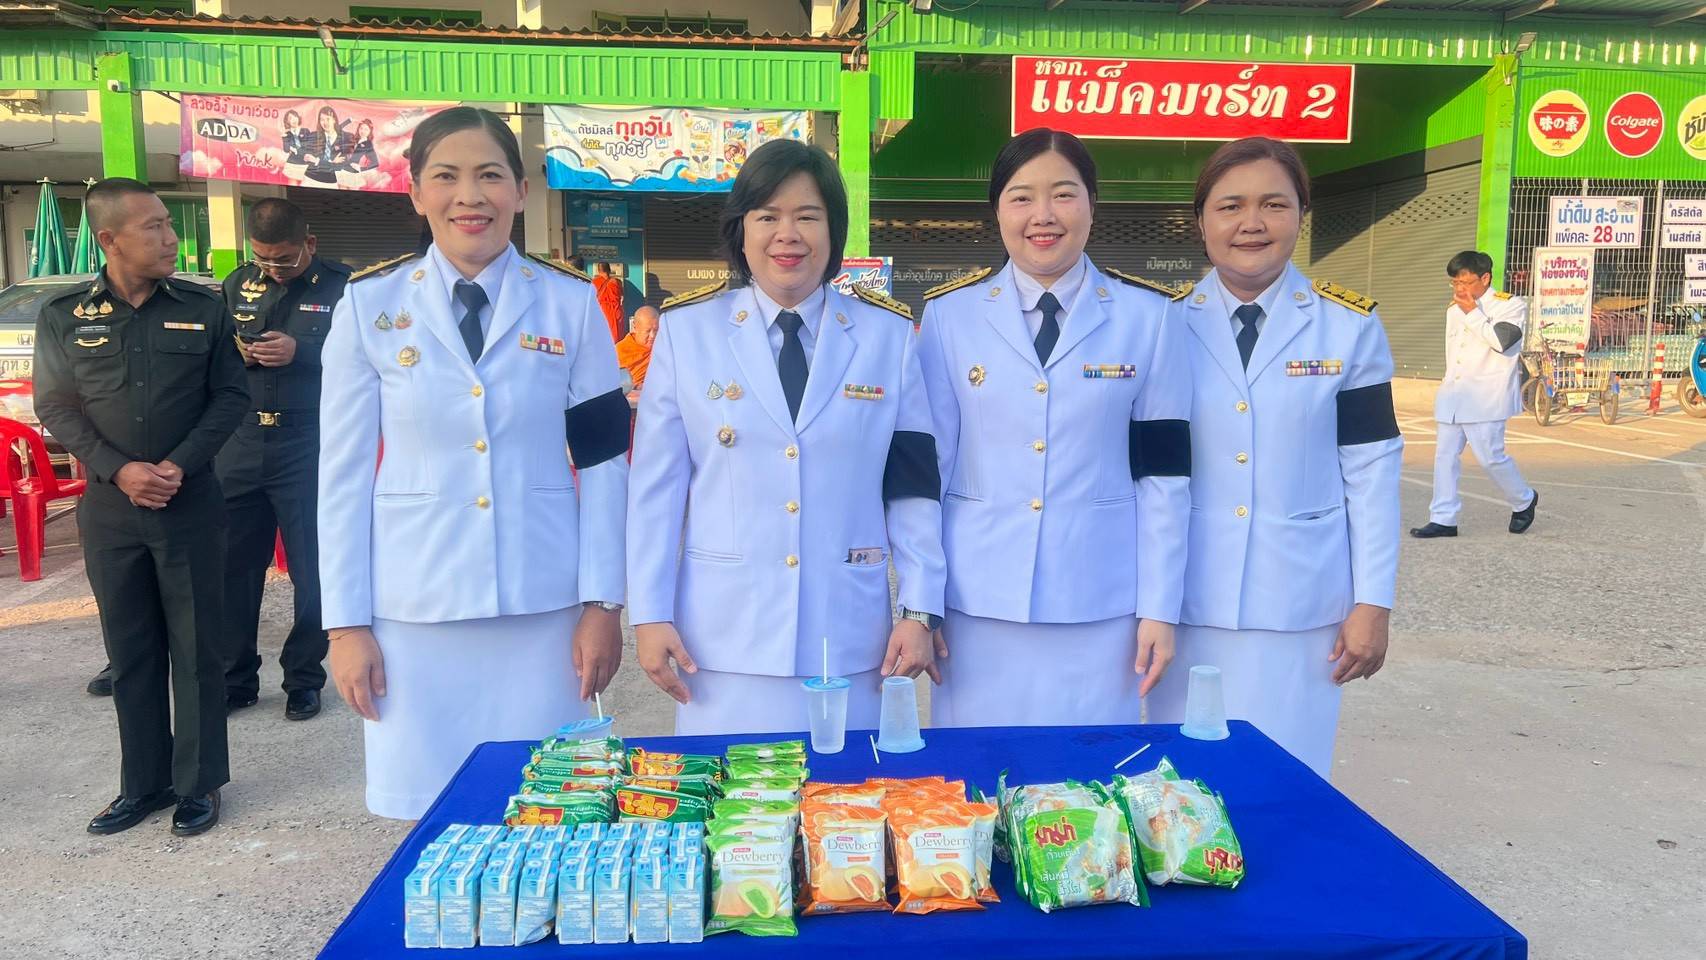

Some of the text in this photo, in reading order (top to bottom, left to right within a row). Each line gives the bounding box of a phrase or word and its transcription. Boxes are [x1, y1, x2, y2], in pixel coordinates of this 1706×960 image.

[1030, 61, 1337, 118] แม็คมาร์ท 2
[200, 121, 251, 140] ADDA
[616, 115, 673, 142] ทุกวัน
[1539, 115, 1580, 133] 味の素
[1610, 115, 1660, 129] Colgate
[1593, 225, 1613, 243] 28
[1615, 232, 1635, 243] บาท
[722, 852, 785, 866] Dewberry
